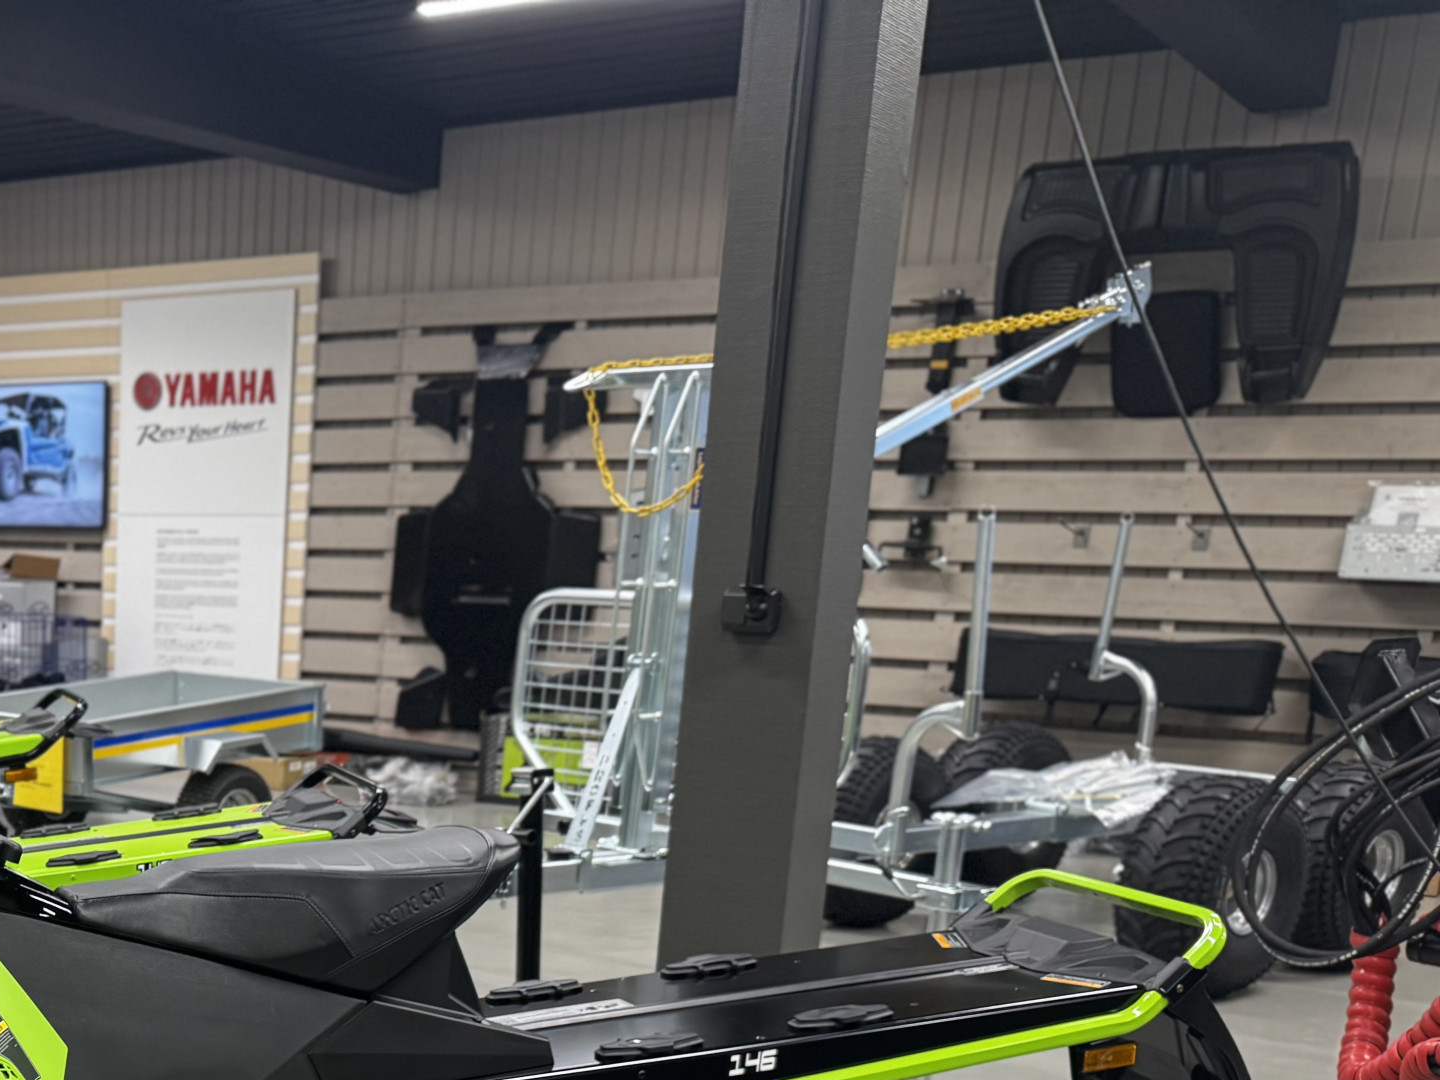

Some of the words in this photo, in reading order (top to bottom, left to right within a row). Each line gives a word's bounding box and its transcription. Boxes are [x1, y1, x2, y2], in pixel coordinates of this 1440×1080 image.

[164, 368, 276, 408] YAMAHA
[136, 423, 186, 447] Revs
[186, 424, 223, 444] Your
[223, 418, 267, 436] Heart
[367, 895, 421, 936] ARCTIC
[419, 881, 446, 908] CAT
[728, 1048, 778, 1077] 146
